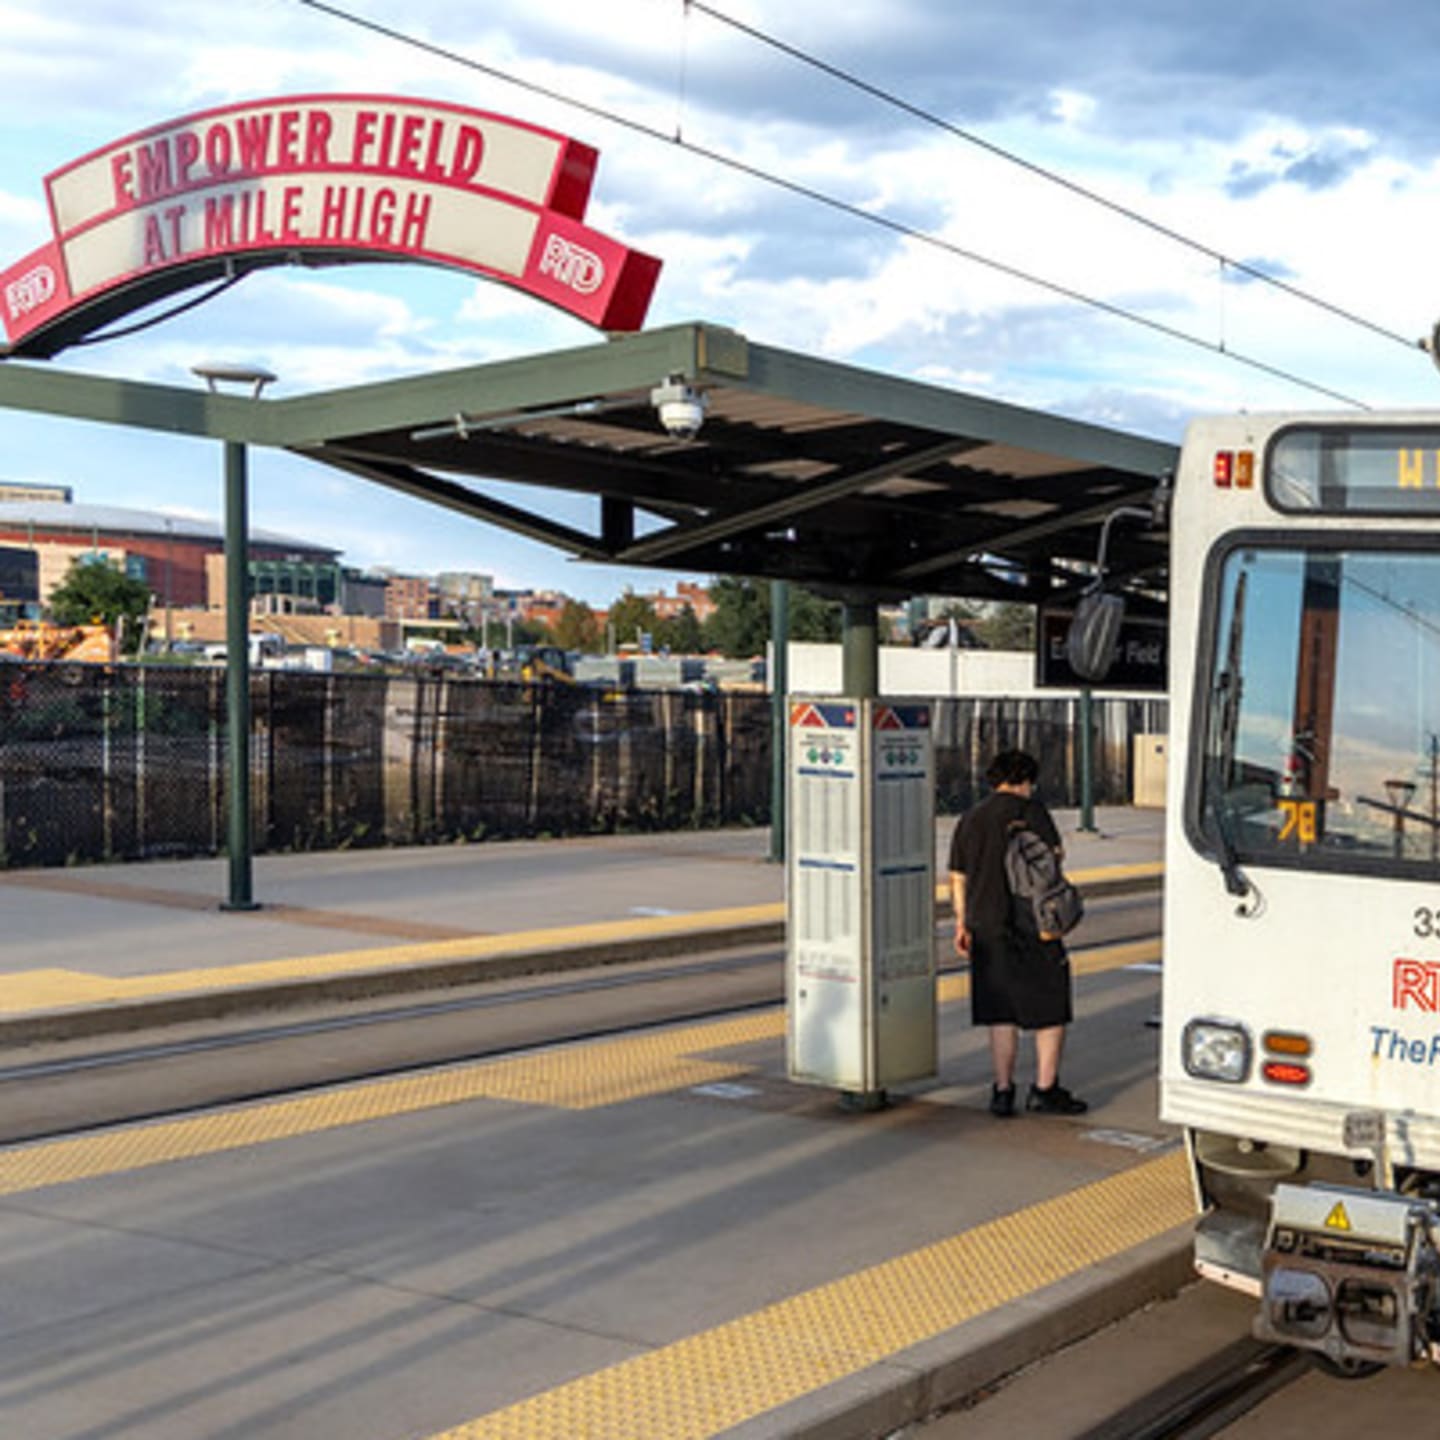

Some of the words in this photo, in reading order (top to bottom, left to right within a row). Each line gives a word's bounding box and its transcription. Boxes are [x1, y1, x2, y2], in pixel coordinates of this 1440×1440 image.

[111, 109, 334, 209] EMPOWER
[351, 111, 485, 184] FIELD
[143, 203, 187, 266] AT
[203, 185, 304, 251] MILE
[319, 185, 432, 251] HIGH
[4, 264, 57, 321] RTD
[538, 232, 605, 296] RTD
[1398, 448, 1422, 488] W
[1277, 800, 1317, 843] 78
